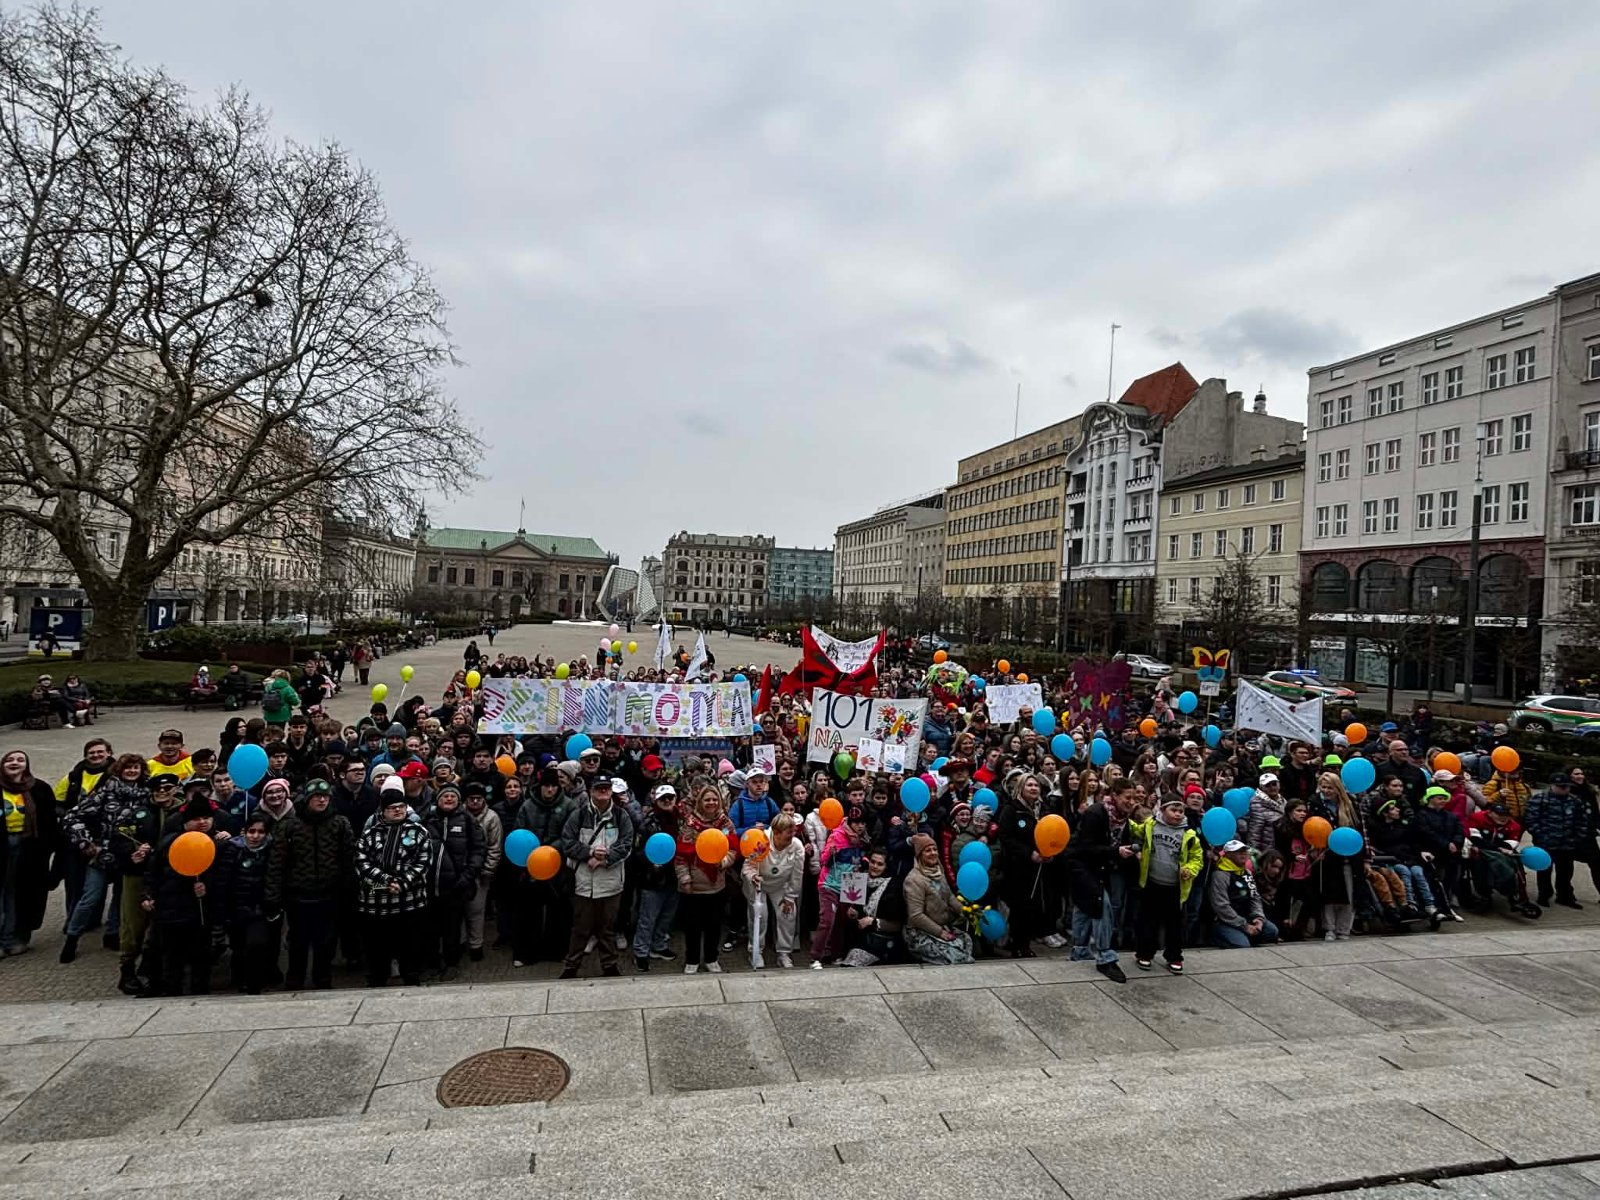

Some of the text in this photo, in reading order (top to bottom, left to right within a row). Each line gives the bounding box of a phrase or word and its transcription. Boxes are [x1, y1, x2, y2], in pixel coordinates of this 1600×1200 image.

[48, 613, 64, 628] P
[157, 606, 167, 626] P
[482, 682, 745, 729] DZIEŃ MOTYLA
[818, 691, 874, 731] 101
[814, 727, 844, 749] NA
